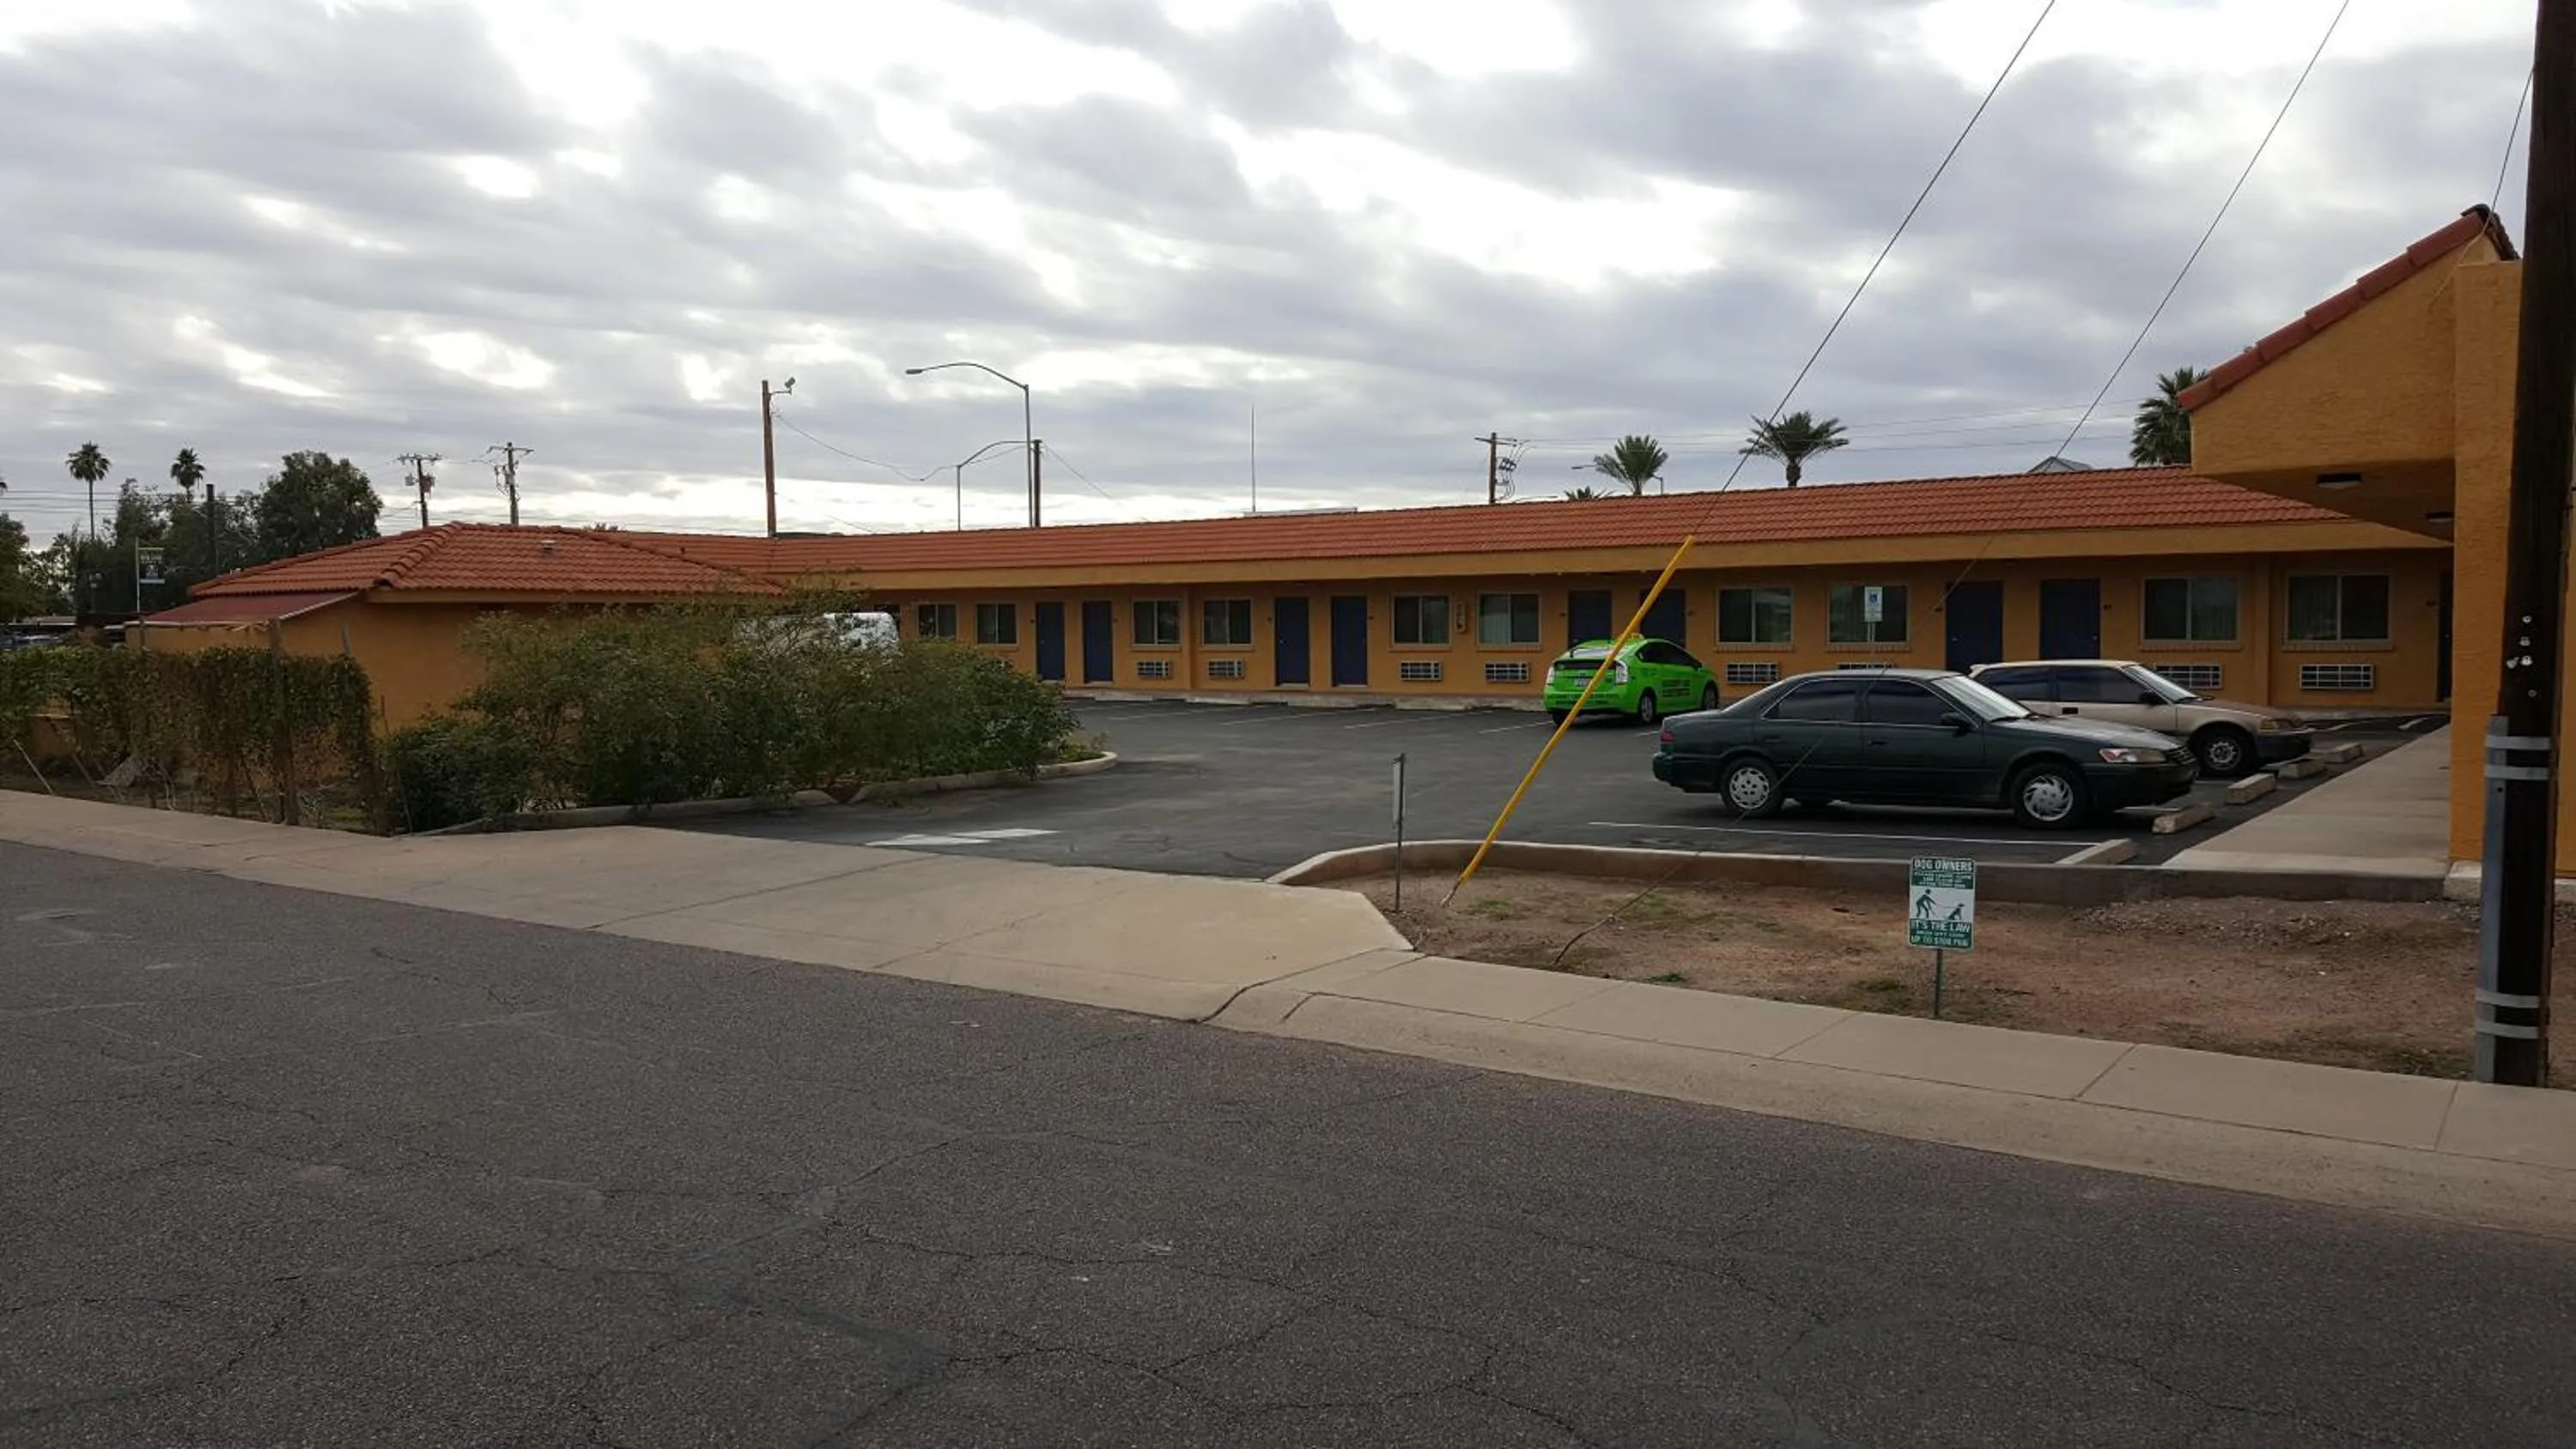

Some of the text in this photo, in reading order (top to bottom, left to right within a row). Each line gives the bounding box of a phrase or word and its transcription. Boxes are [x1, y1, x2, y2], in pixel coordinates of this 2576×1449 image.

[1914, 859, 1972, 871] DOG OWNERS
[1931, 922, 1948, 931] THE
[1950, 923, 1971, 933] LAW
